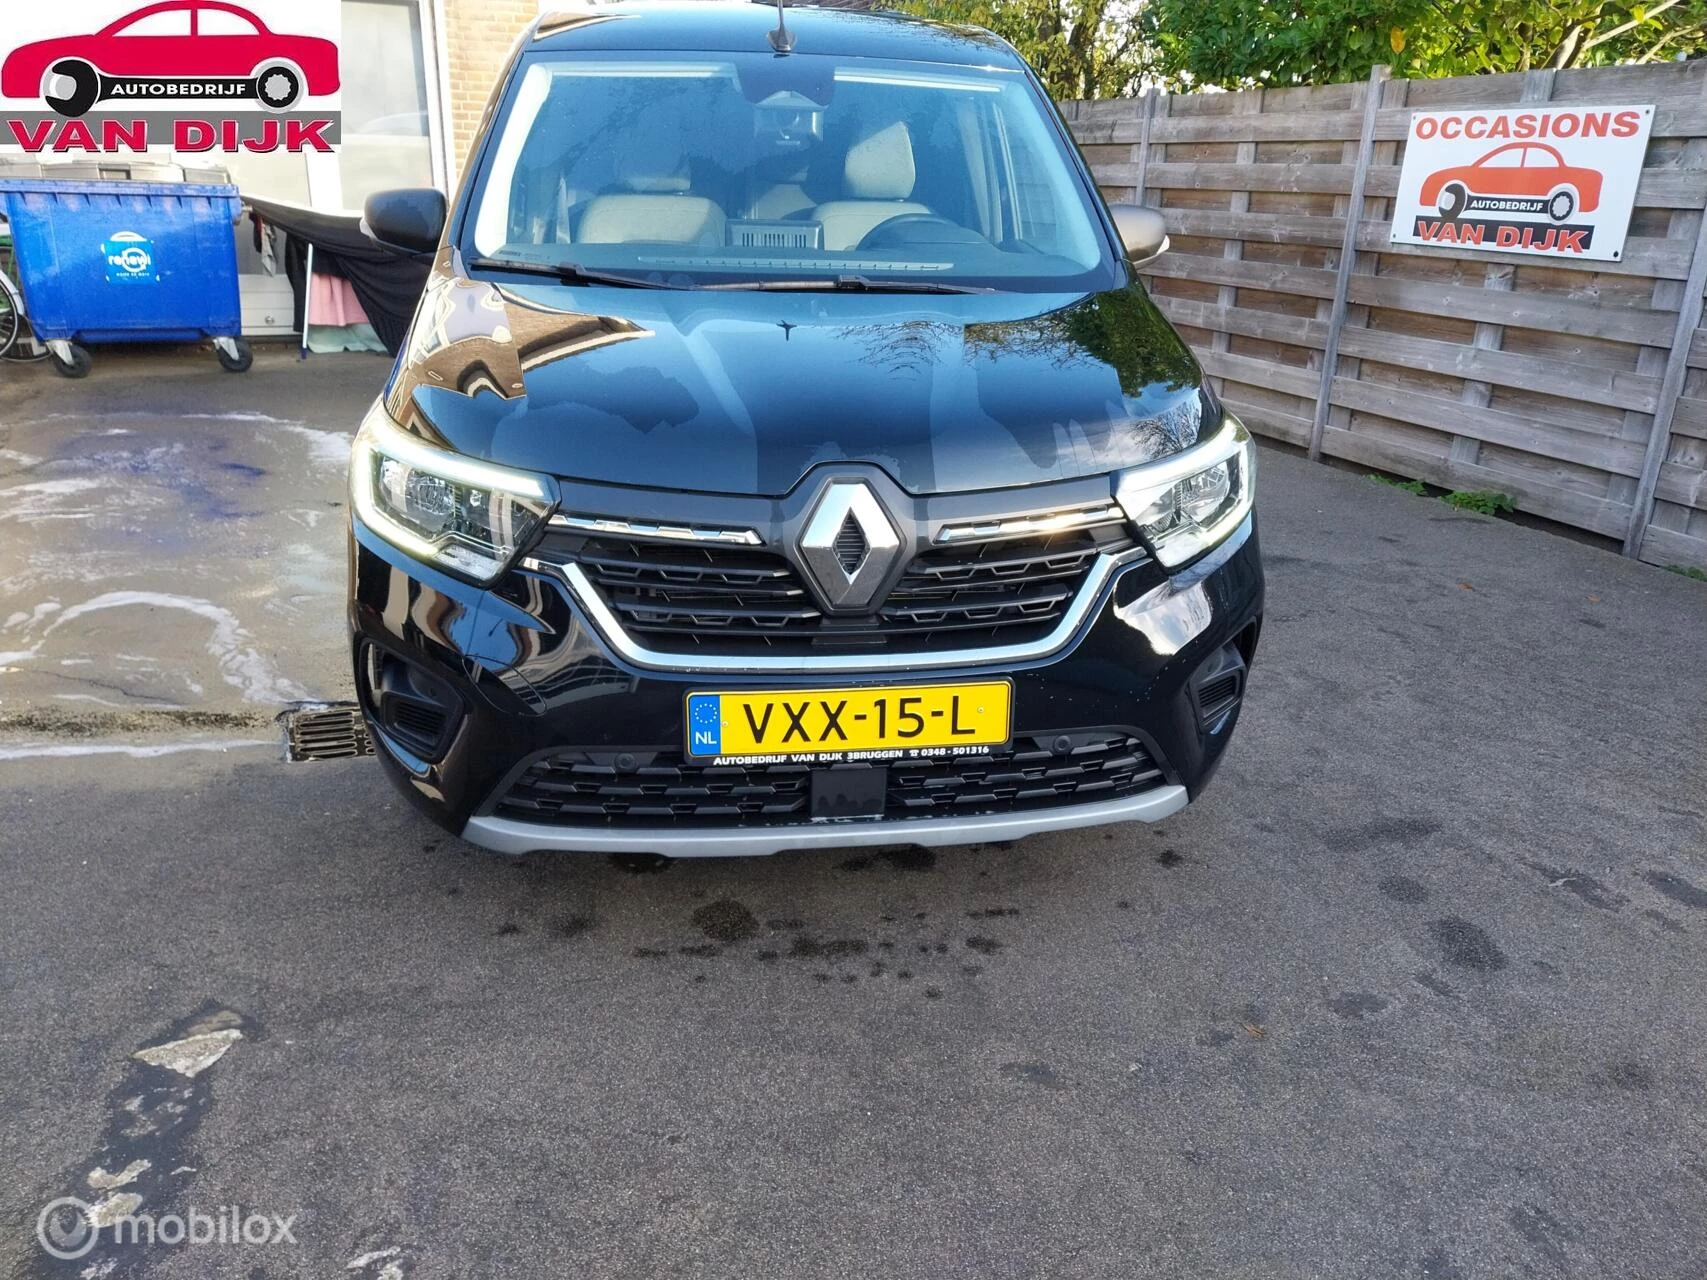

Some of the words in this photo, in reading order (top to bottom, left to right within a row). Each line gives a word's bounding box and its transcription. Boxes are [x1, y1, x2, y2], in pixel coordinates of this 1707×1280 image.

[1415, 111, 1641, 140] OCCASIONS
[1470, 199, 1544, 212] AUTOBEDRIJF
[1417, 220, 1486, 246] VAN
[1495, 224, 1590, 254] DIJK
[743, 695, 976, 744] VXX-15-L
[695, 731, 717, 745] NL
[713, 755, 787, 766] AUTOBEDRIJF
[791, 753, 815, 763] VAN
[819, 752, 843, 762] DIJK
[847, 750, 903, 760] 3BRUGGEN
[921, 747, 946, 757] 0348
[952, 745, 990, 755] 501316
